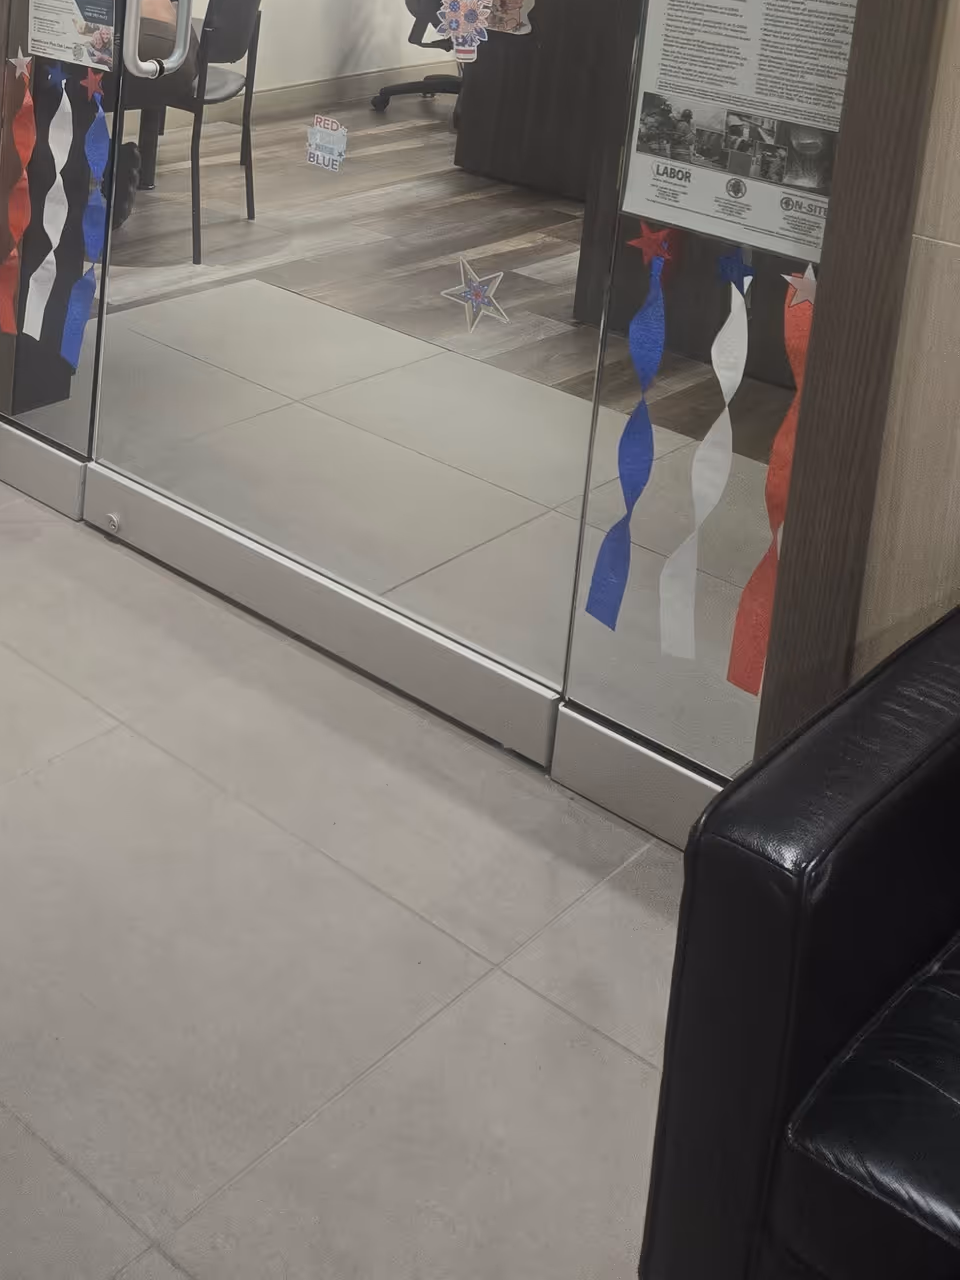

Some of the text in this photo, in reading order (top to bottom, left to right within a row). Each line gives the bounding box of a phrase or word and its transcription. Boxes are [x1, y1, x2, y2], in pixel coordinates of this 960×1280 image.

[315, 116, 339, 131] RED
[309, 152, 338, 170] BLUE
[656, 164, 692, 183] LABOR
